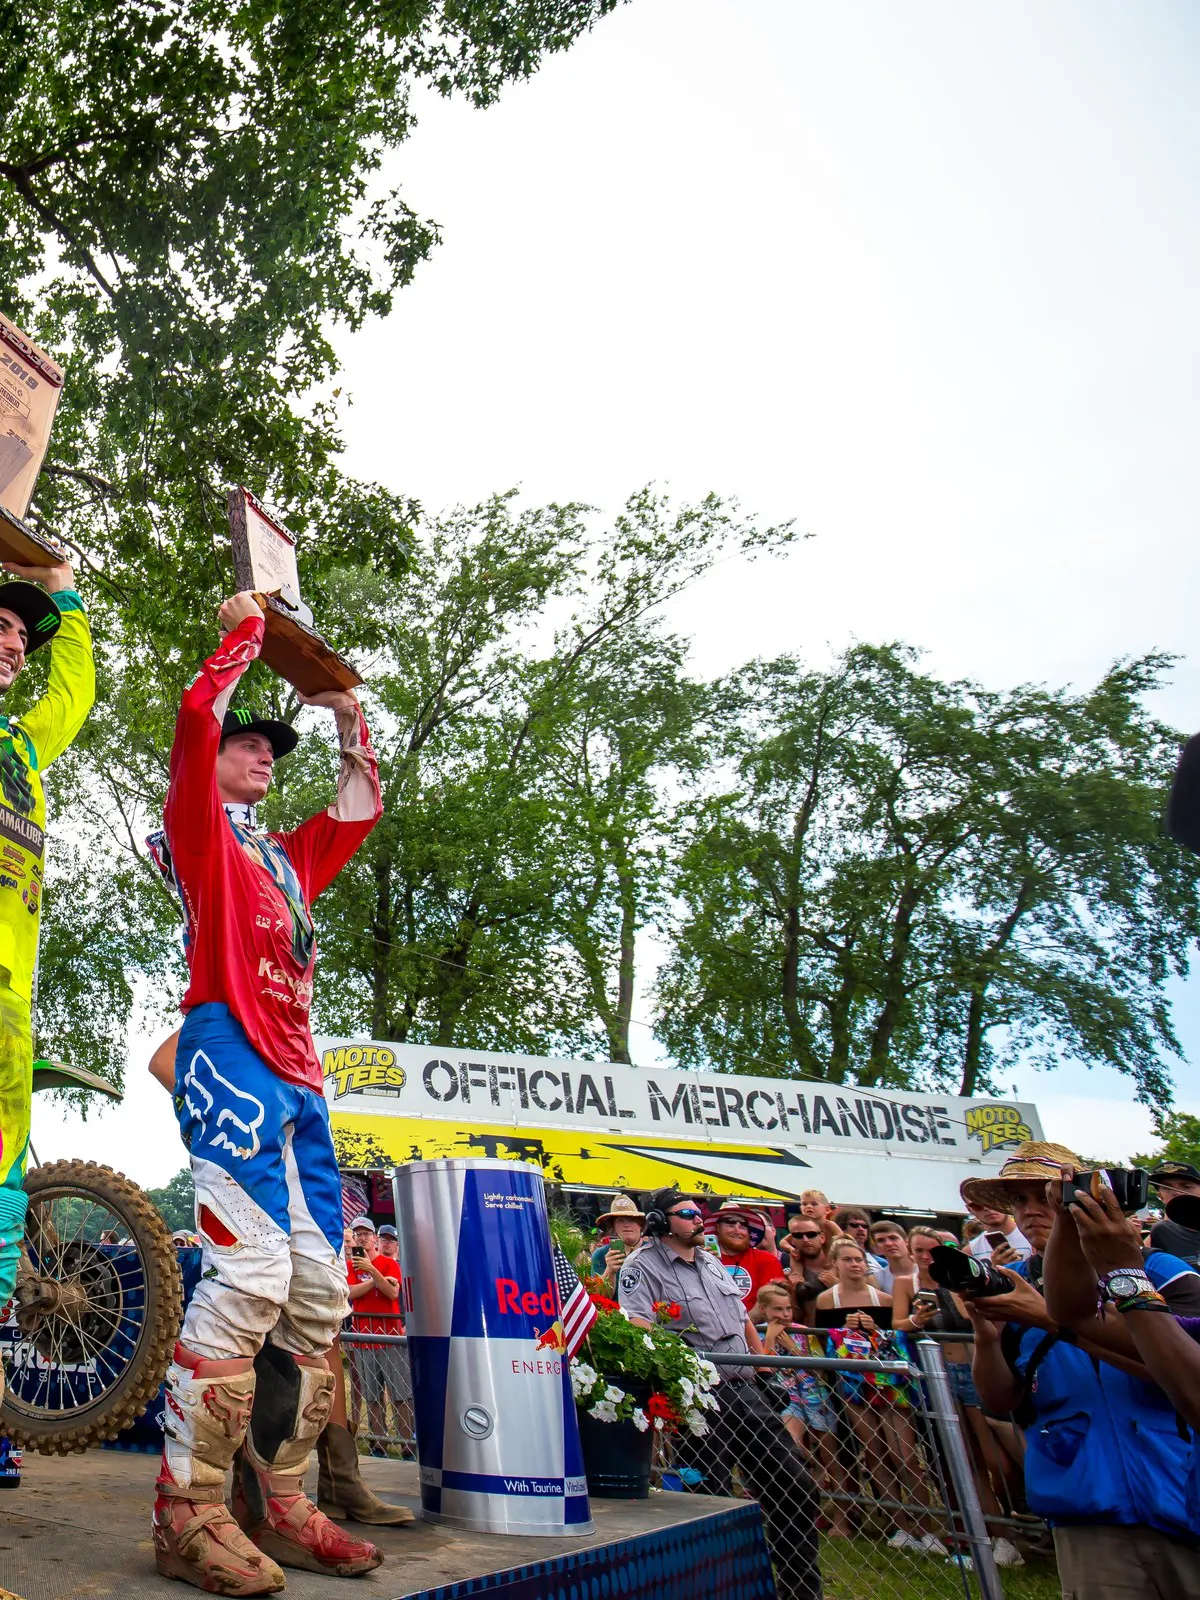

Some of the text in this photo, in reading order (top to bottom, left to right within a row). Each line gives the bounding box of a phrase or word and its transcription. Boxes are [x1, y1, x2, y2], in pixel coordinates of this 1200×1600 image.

[0, 387, 20, 408] REDBUD
[261, 987, 292, 1004] PRO
[323, 1046, 396, 1074] MOTO
[334, 1065, 406, 1097] TEES
[422, 1059, 957, 1146] OFFICIAL MERCHANDISE
[965, 1105, 1022, 1135] MOTO
[978, 1122, 1033, 1154] TEES
[484, 1193, 504, 1201] Lightly
[485, 1201, 503, 1209] Serve
[496, 1277, 557, 1316] Red
[504, 1480, 529, 1493] With
[531, 1481, 563, 1493] Taurine.
